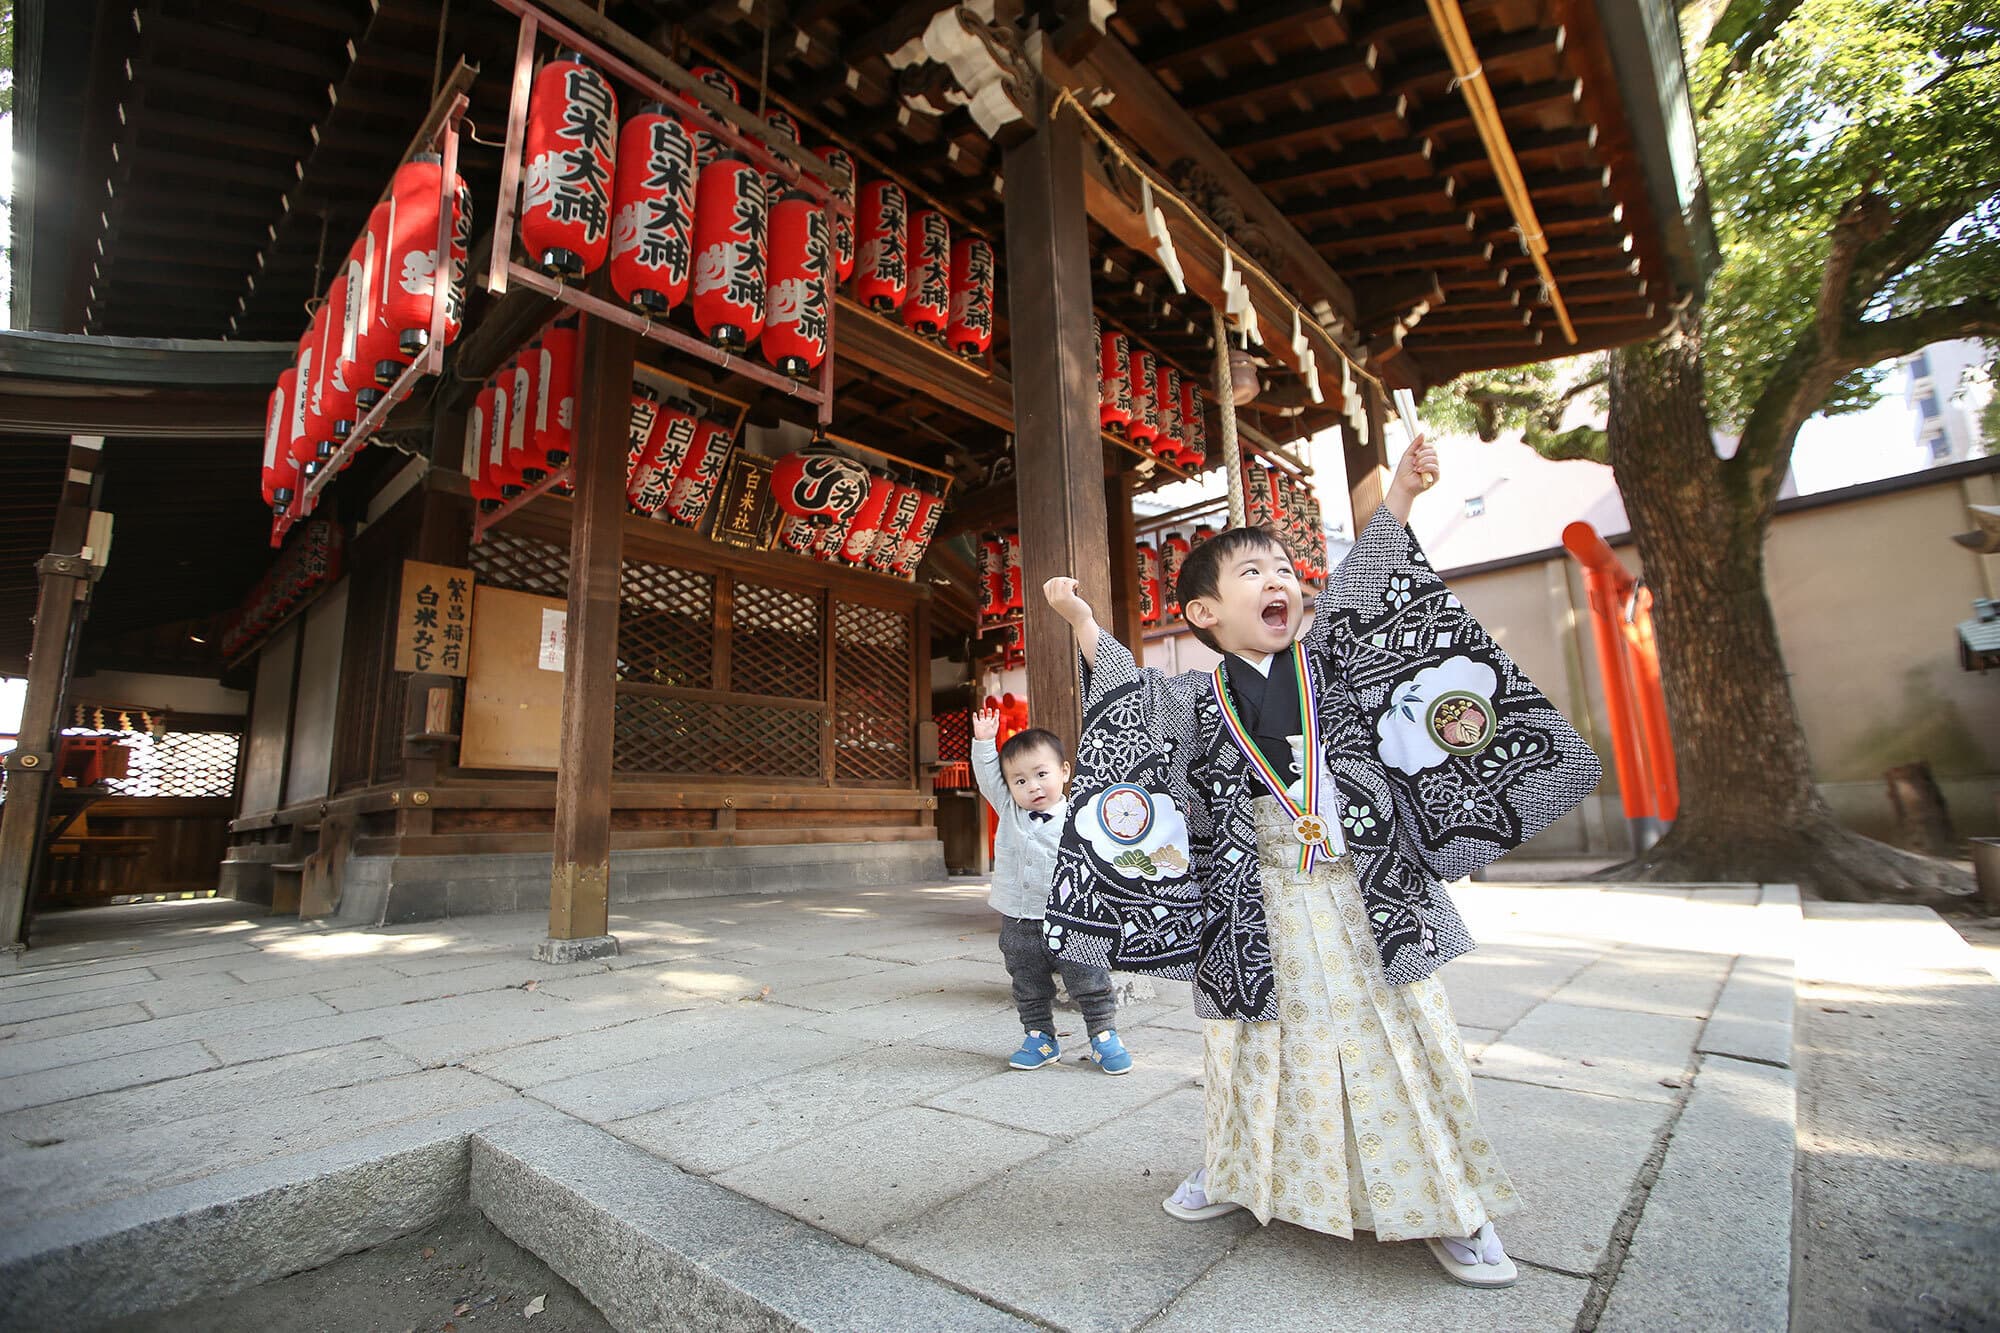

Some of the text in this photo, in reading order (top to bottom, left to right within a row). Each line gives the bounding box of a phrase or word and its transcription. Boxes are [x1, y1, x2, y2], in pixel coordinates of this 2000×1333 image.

[549, 69, 614, 242] 白米大神
[639, 121, 696, 284] 白米大神
[725, 168, 768, 322] 白米大神
[876, 185, 908, 291] 白米大神
[796, 210, 830, 355] 白米大神
[921, 213, 949, 316] 白米大神
[964, 242, 993, 339] 白米大神
[637, 419, 696, 511] 白米大神
[678, 432, 732, 520] 白米大神
[732, 467, 761, 530] 白米社
[874, 493, 920, 567] 白米大神
[902, 504, 944, 570] 白米大神
[1291, 489, 1311, 561] 白米大神
[412, 584, 439, 671] 白米みくじ
[440, 577, 467, 670] 繁昌稲荷
